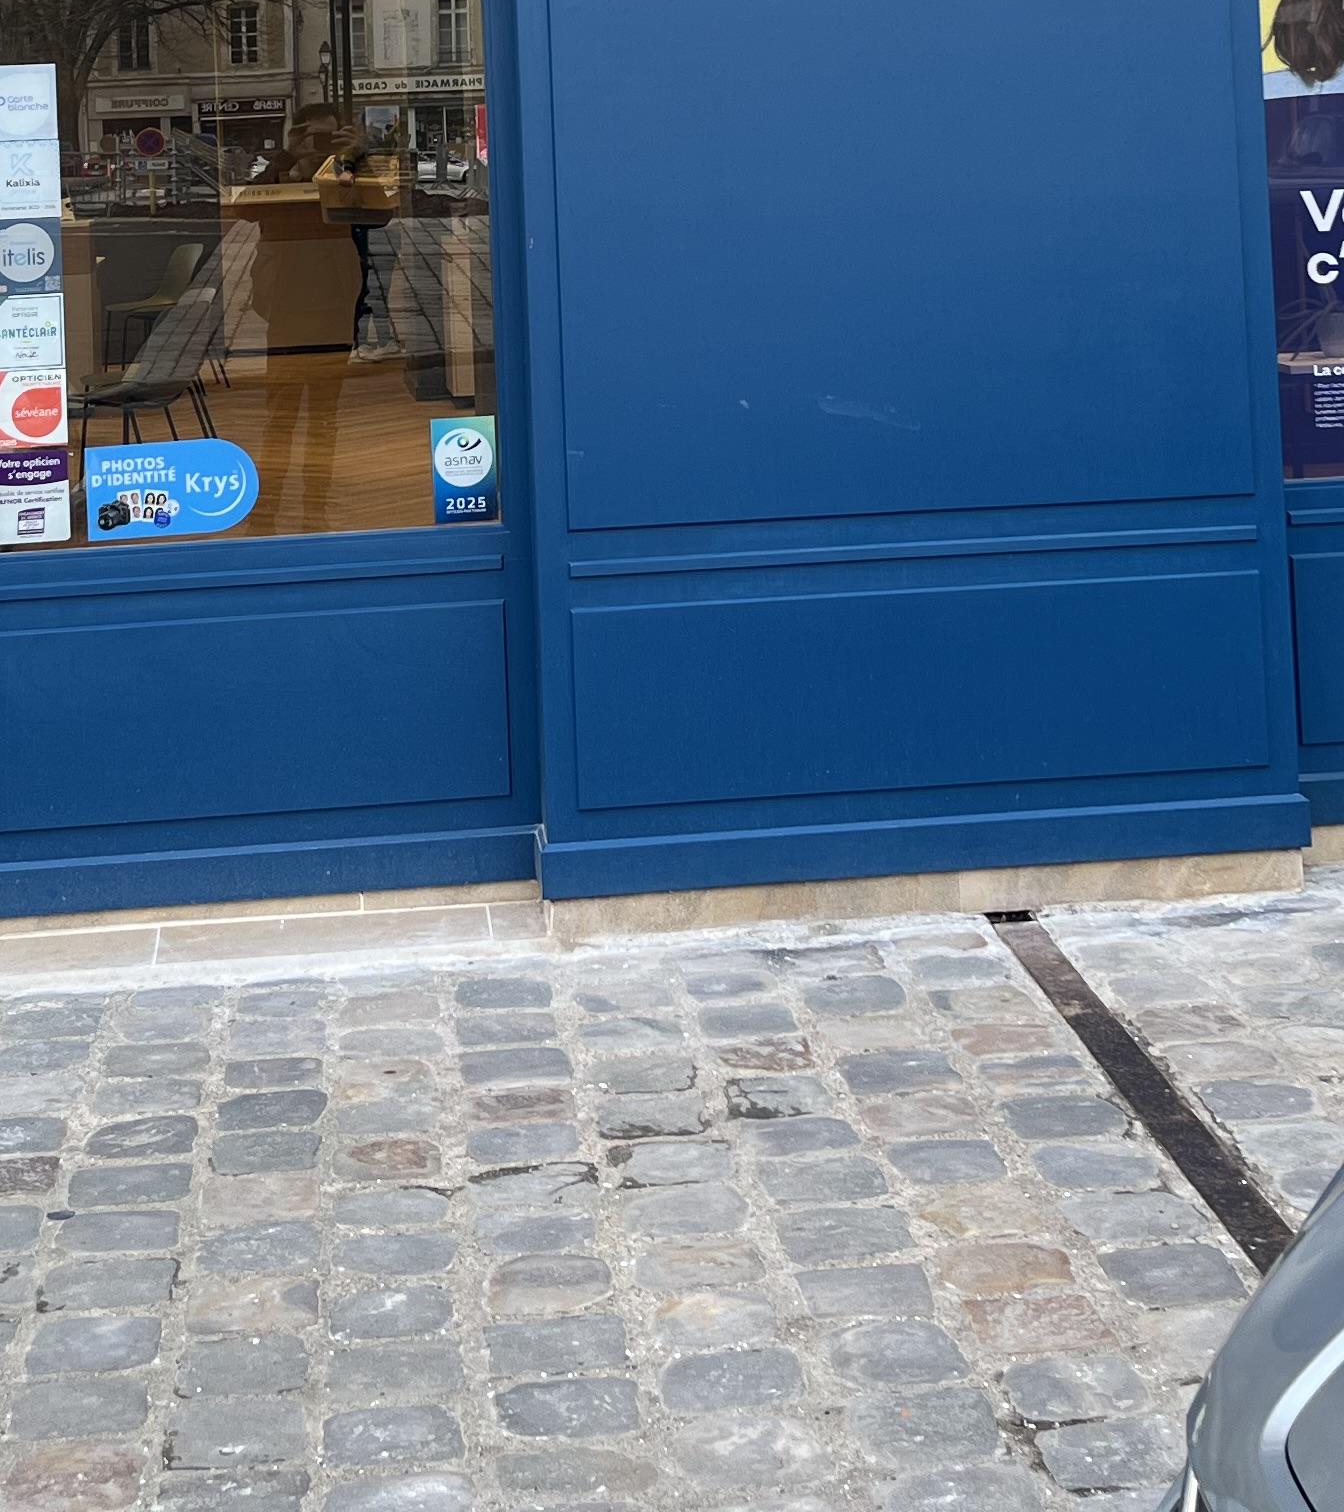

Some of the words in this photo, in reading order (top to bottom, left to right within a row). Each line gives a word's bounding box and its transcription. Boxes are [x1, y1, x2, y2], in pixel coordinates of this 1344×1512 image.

[6, 178, 40, 188] Kalixia
[2, 248, 46, 267] itelis
[1313, 364, 1331, 377] La
[12, 374, 62, 383] OPTICIEN
[15, 406, 59, 419] sévéane
[22, 456, 60, 469] opticien
[101, 456, 165, 473] PHOTOS
[444, 455, 483, 466] asnav
[7, 469, 52, 481] s'engage
[91, 466, 176, 488] D'IDENTITÉ
[185, 471, 241, 499] Krys
[445, 496, 486, 510] 2025
